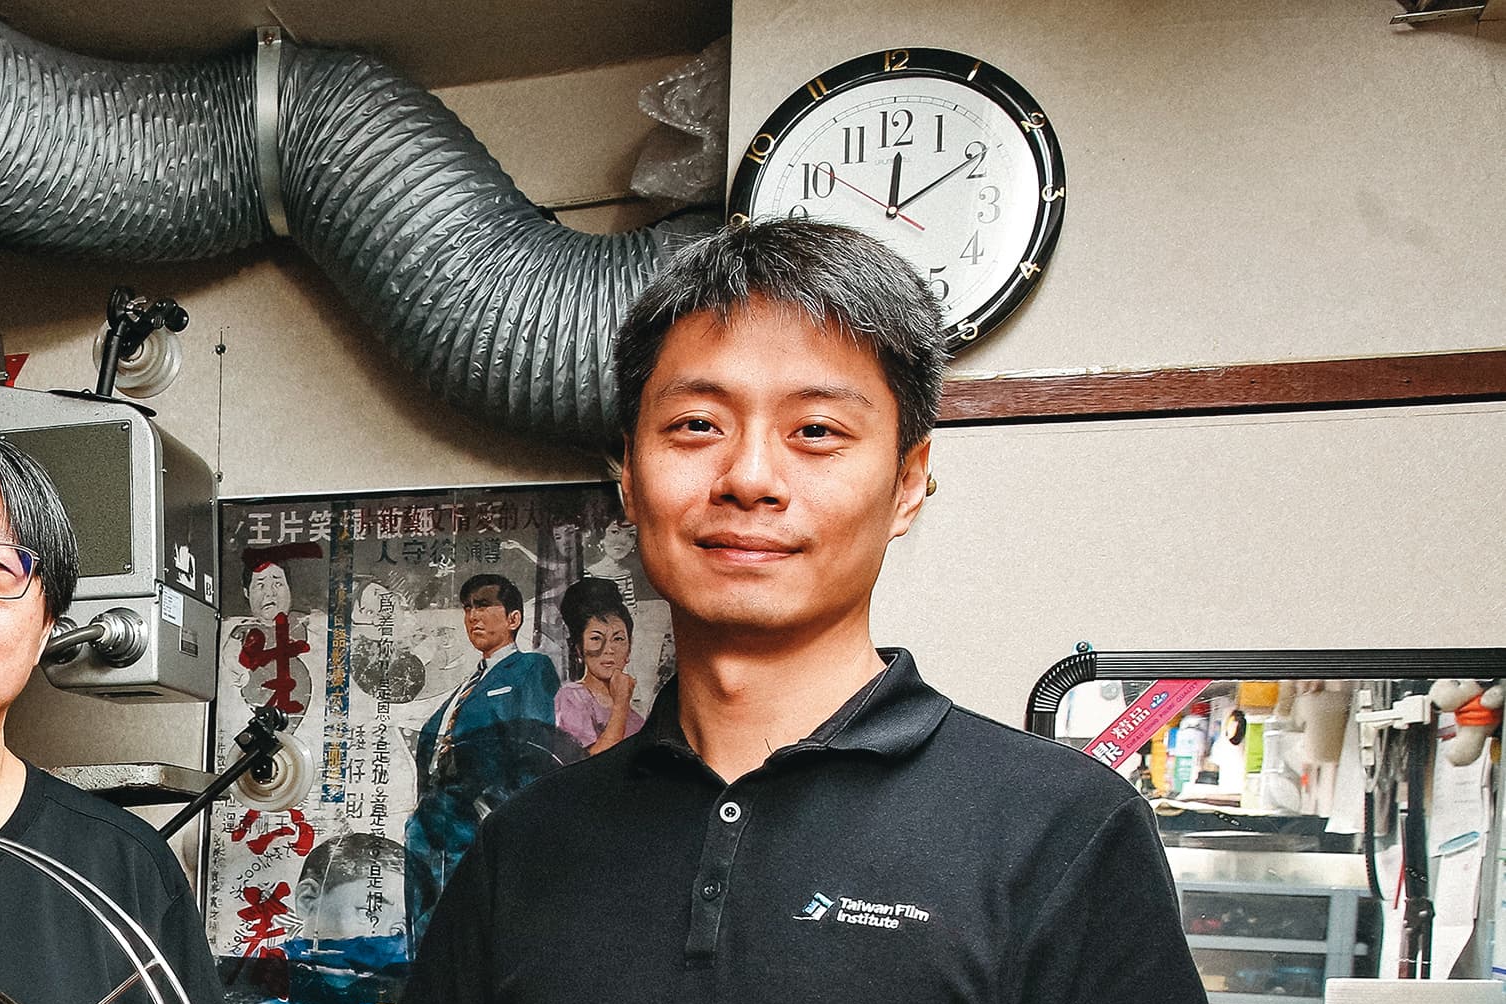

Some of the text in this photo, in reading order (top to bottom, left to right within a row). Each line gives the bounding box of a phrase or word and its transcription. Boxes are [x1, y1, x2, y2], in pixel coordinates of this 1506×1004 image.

[884, 49, 911, 73] 12
[966, 60, 983, 82] 1
[806, 77, 831, 102] 11
[878, 108, 914, 149] 12
[933, 114, 945, 154] 1
[1020, 111, 1047, 134] 2
[745, 132, 775, 165] 10
[841, 126, 867, 165] 11
[965, 140, 990, 180] 2
[801, 161, 836, 201] 10
[1040, 184, 1065, 203] 3
[977, 185, 1001, 224] 3
[959, 230, 985, 265] 4
[926, 264, 950, 303] 5
[1020, 261, 1042, 281] 4
[955, 318, 980, 342] 5
[205, 582, 212, 598] B
[1110, 706, 1151, 740] 精品
[836, 910, 900, 930] Institute
[839, 897, 930, 922] Taiwan Film
